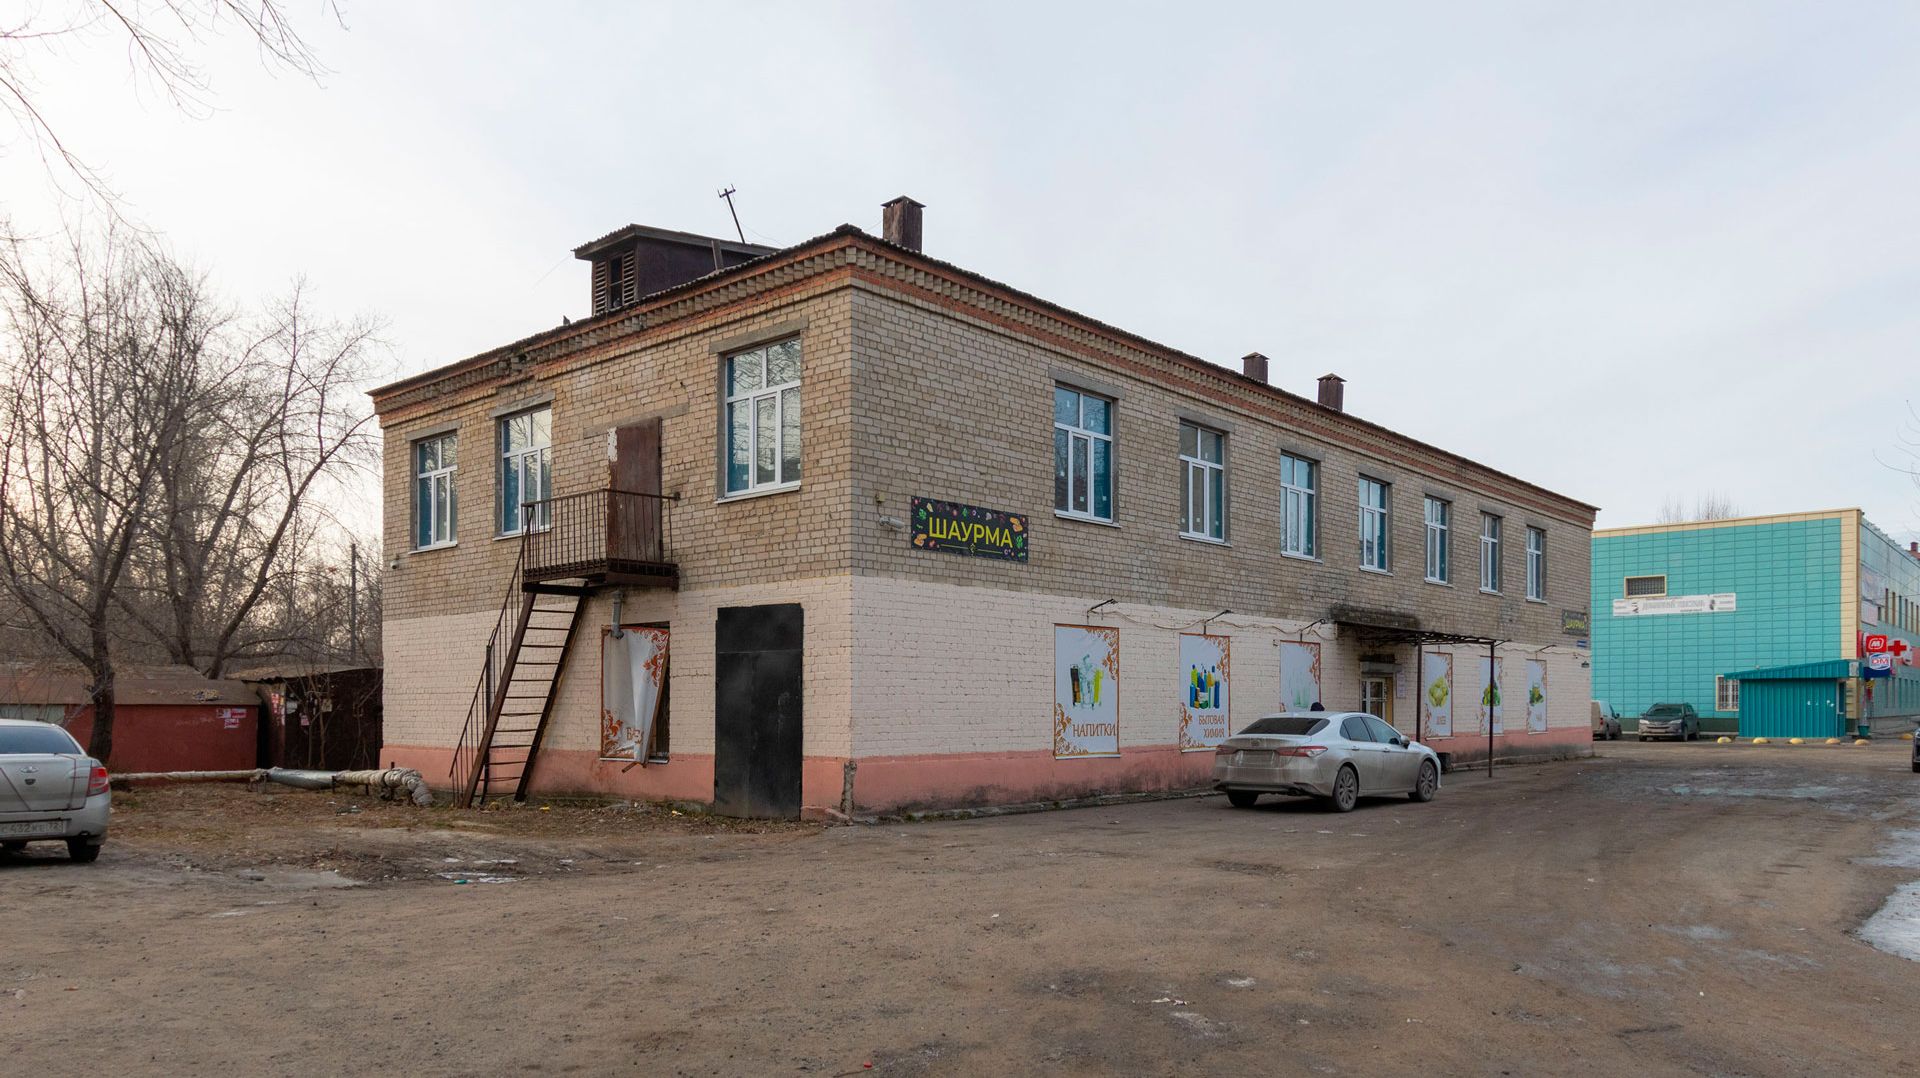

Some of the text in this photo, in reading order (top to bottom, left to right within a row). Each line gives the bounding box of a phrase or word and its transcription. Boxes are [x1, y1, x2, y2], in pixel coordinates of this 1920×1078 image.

[929, 517, 1013, 548] ШАУРМА
[1199, 714, 1225, 725] БЫТОВАЯ
[1072, 723, 1116, 738] НАПИТКИ
[1203, 728, 1225, 738] ХИМИЯ
